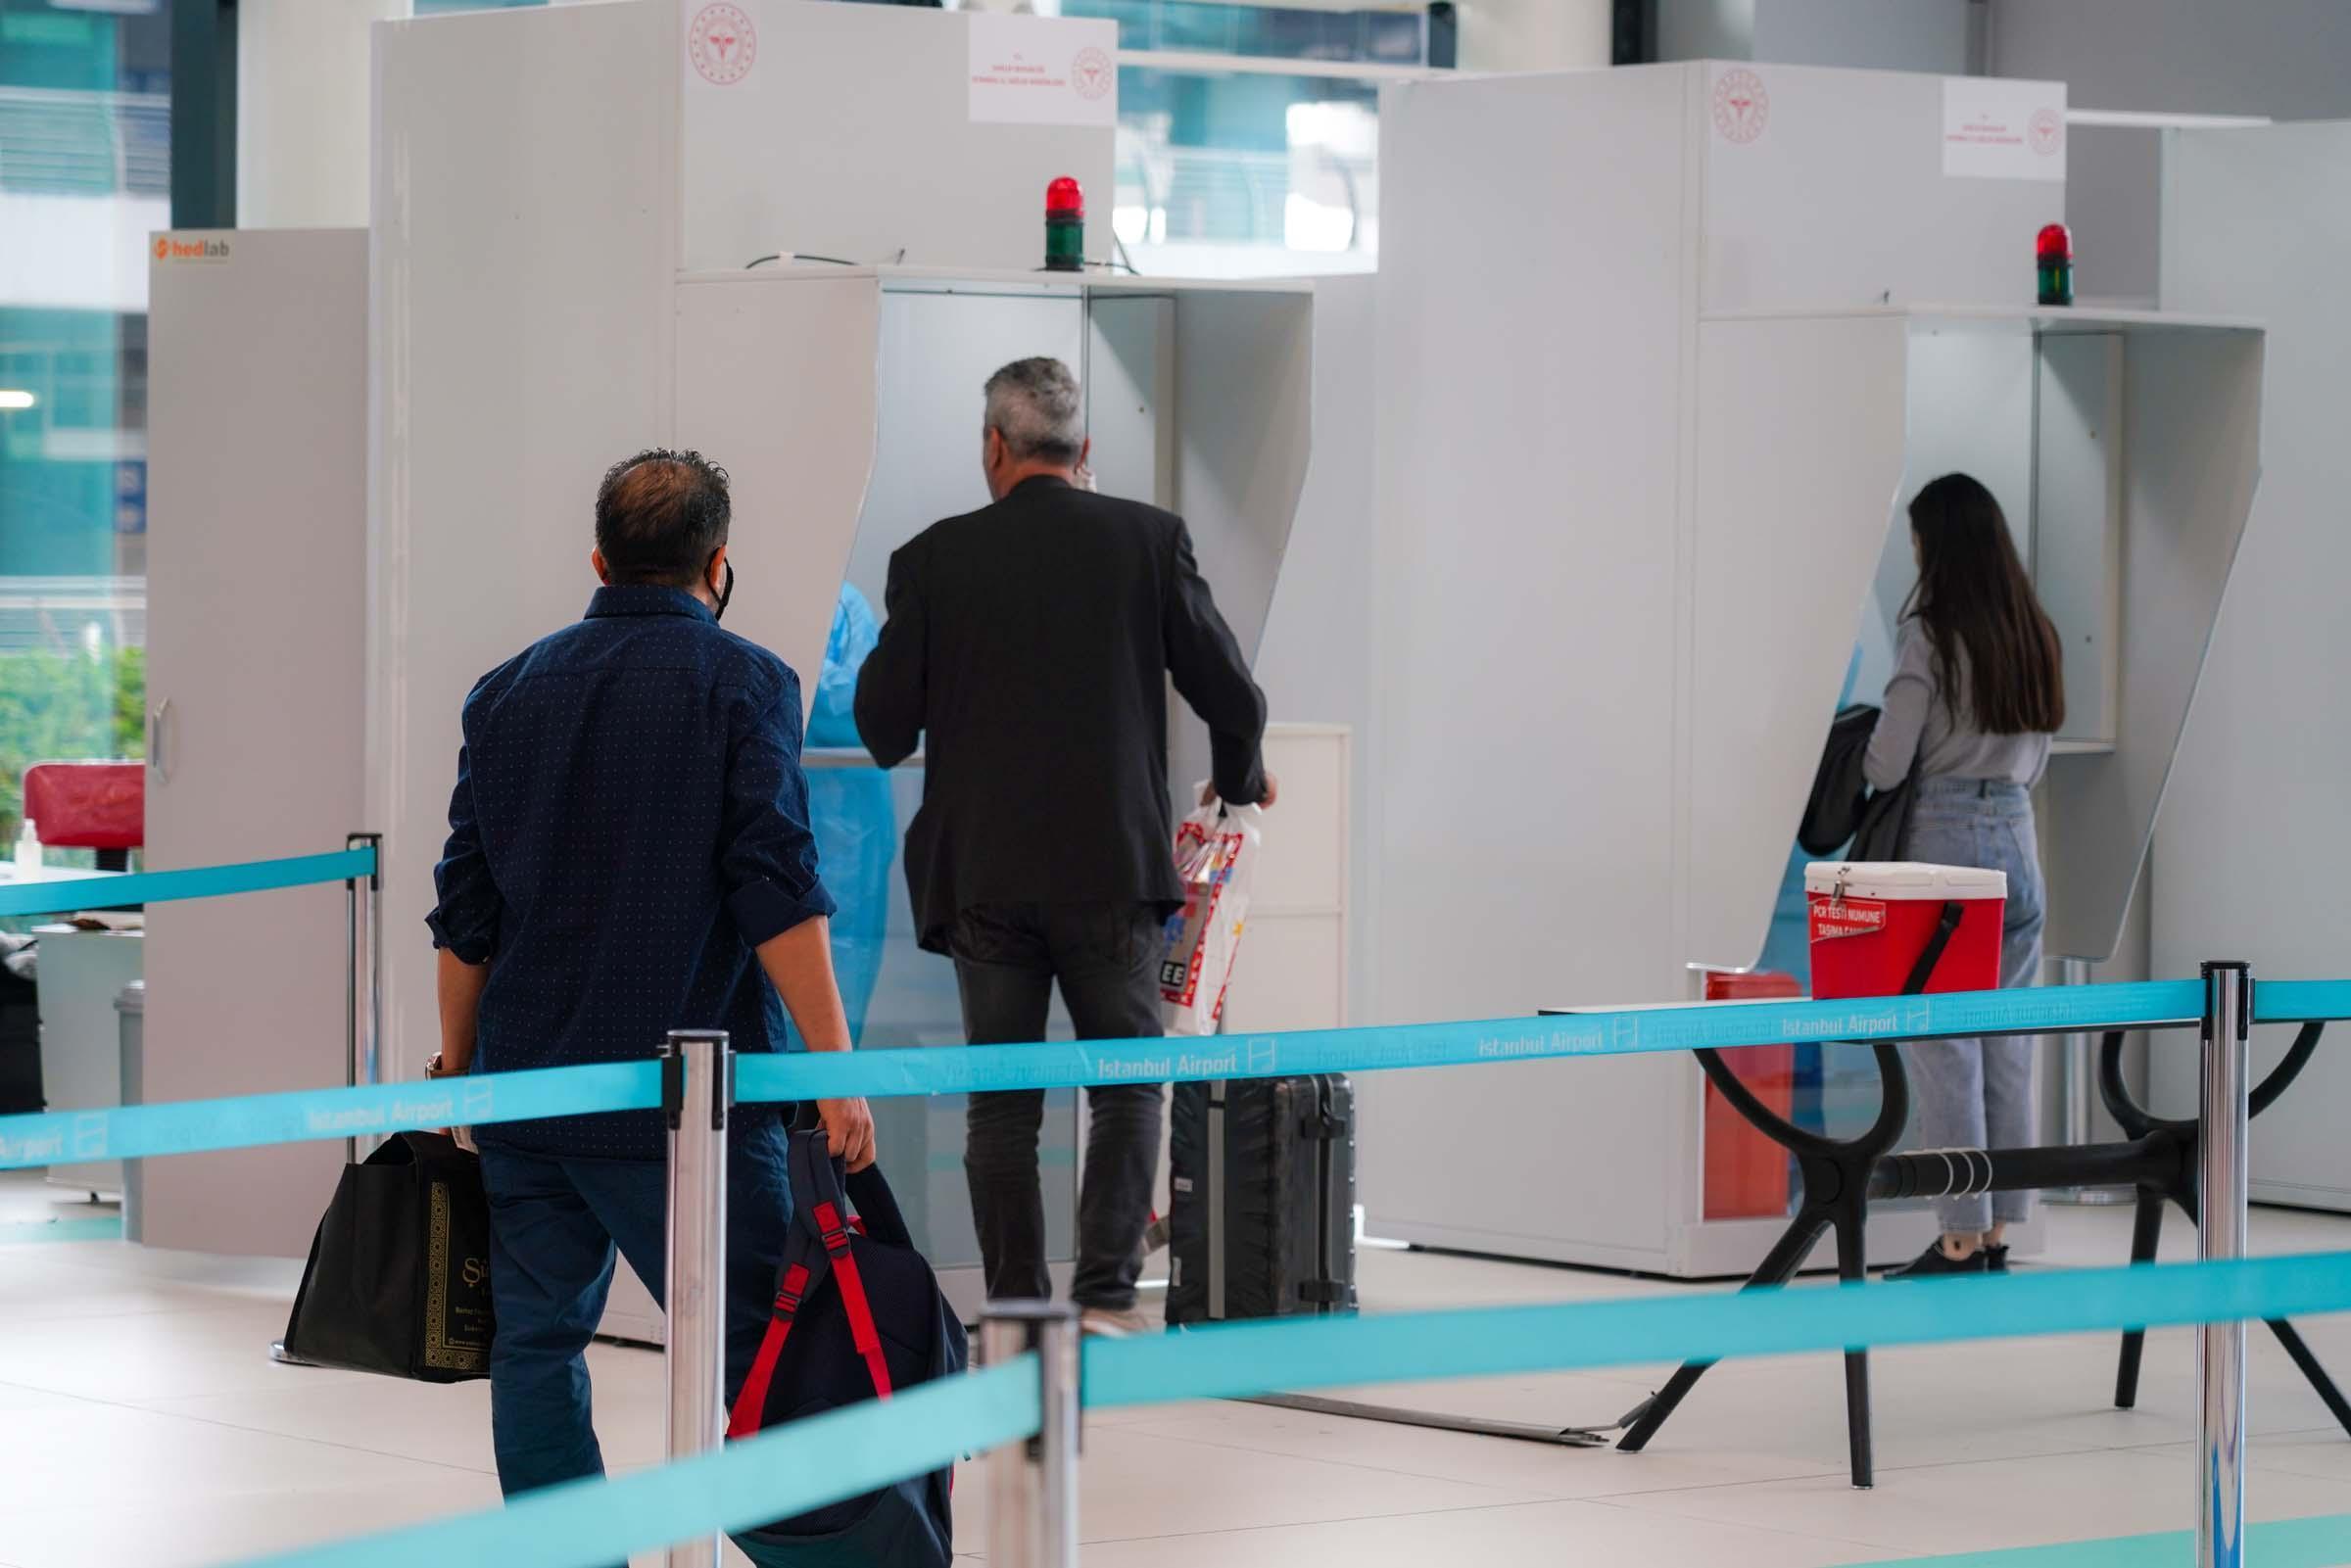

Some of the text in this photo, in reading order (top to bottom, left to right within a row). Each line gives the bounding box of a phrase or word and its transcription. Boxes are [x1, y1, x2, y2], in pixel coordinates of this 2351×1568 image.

[171, 238, 230, 258] hedlab
[1813, 905, 1827, 918] PCR
[1847, 1013, 1897, 1036] Airport
[1552, 1028, 1604, 1054] Airport
[1098, 1057, 1171, 1078] Istanbul
[1176, 1051, 1237, 1076] Airport
[309, 1094, 455, 1132] Istanbul Airport
